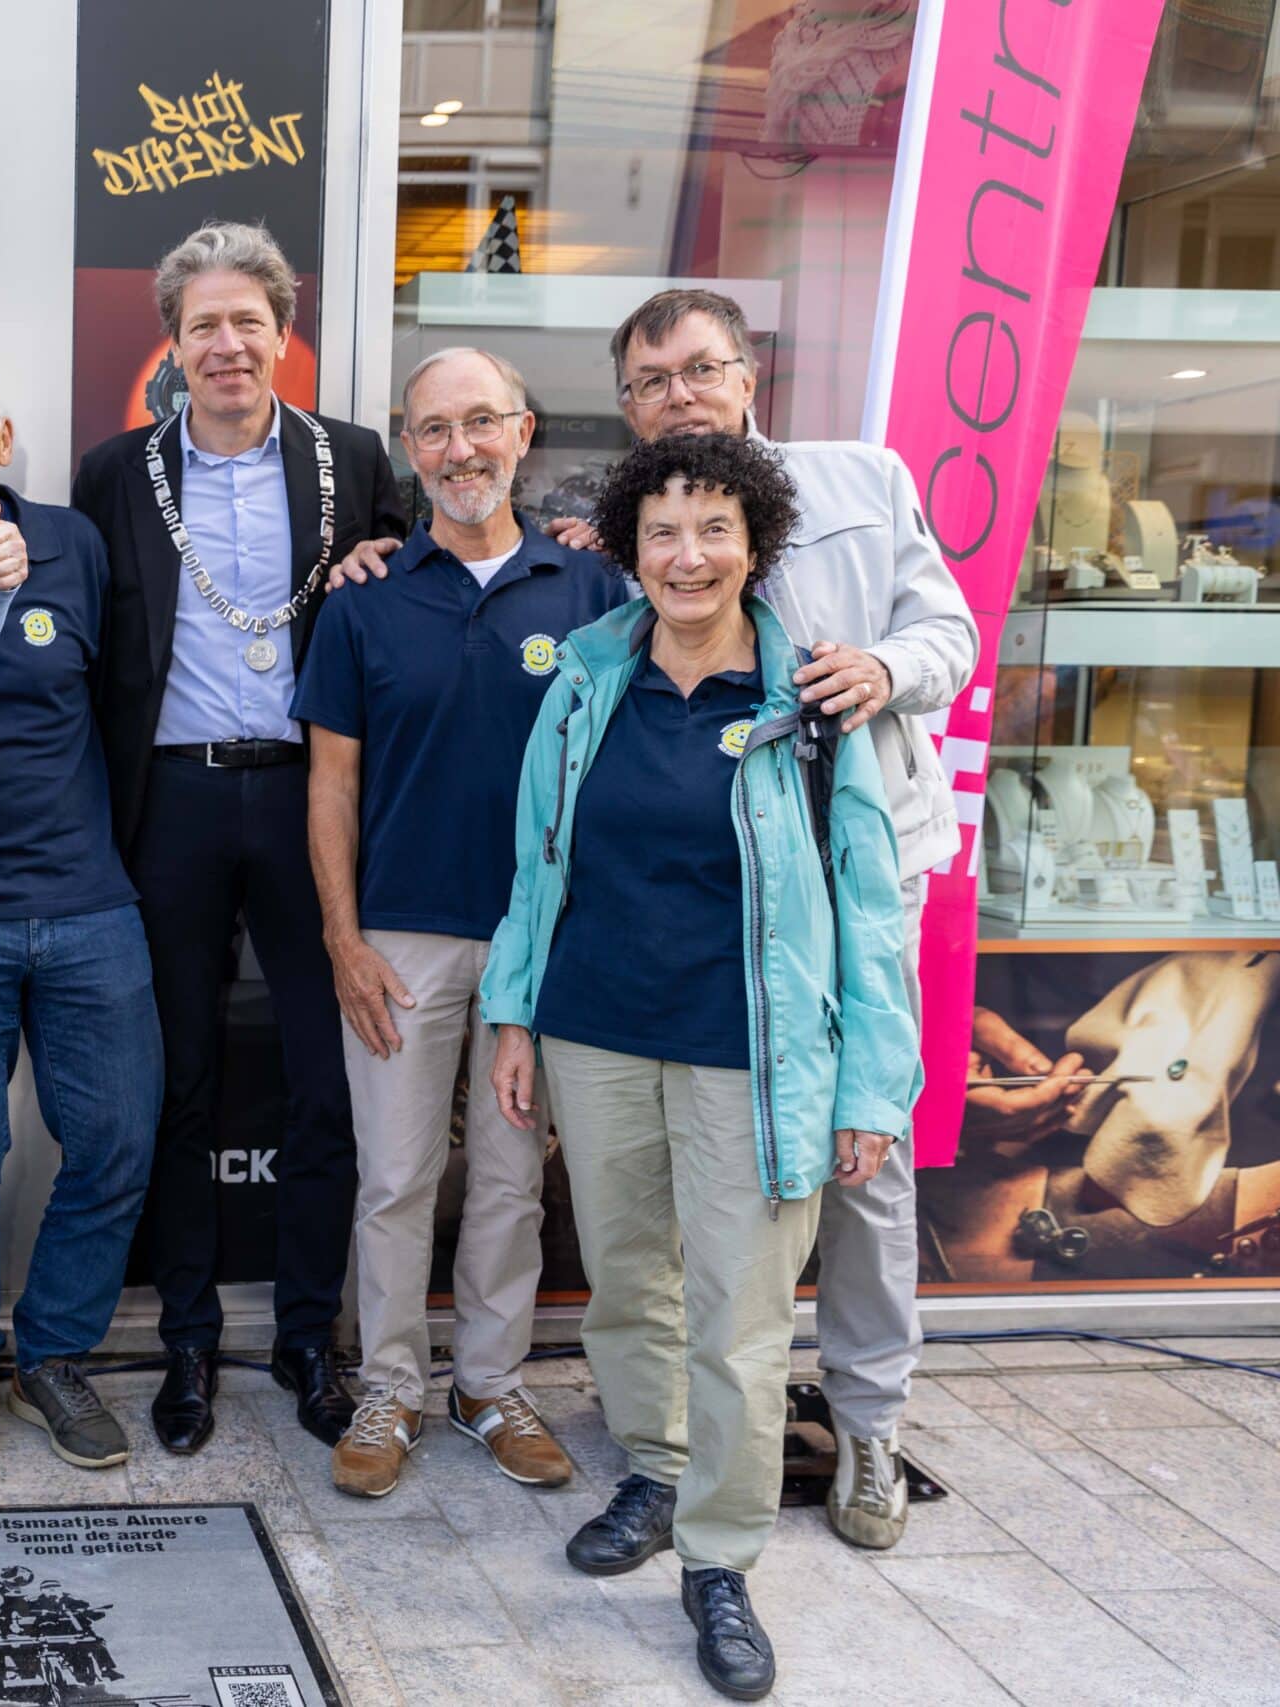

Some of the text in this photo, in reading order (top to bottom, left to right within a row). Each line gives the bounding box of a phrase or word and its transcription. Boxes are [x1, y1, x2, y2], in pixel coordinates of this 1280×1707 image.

[926, 0, 1072, 562] centr
[126, 1514, 208, 1527] Almere
[5, 1528, 177, 1543] Samen de aarde
[23, 1541, 166, 1556] rond gefietst
[213, 1666, 289, 1676] LEES MEER
